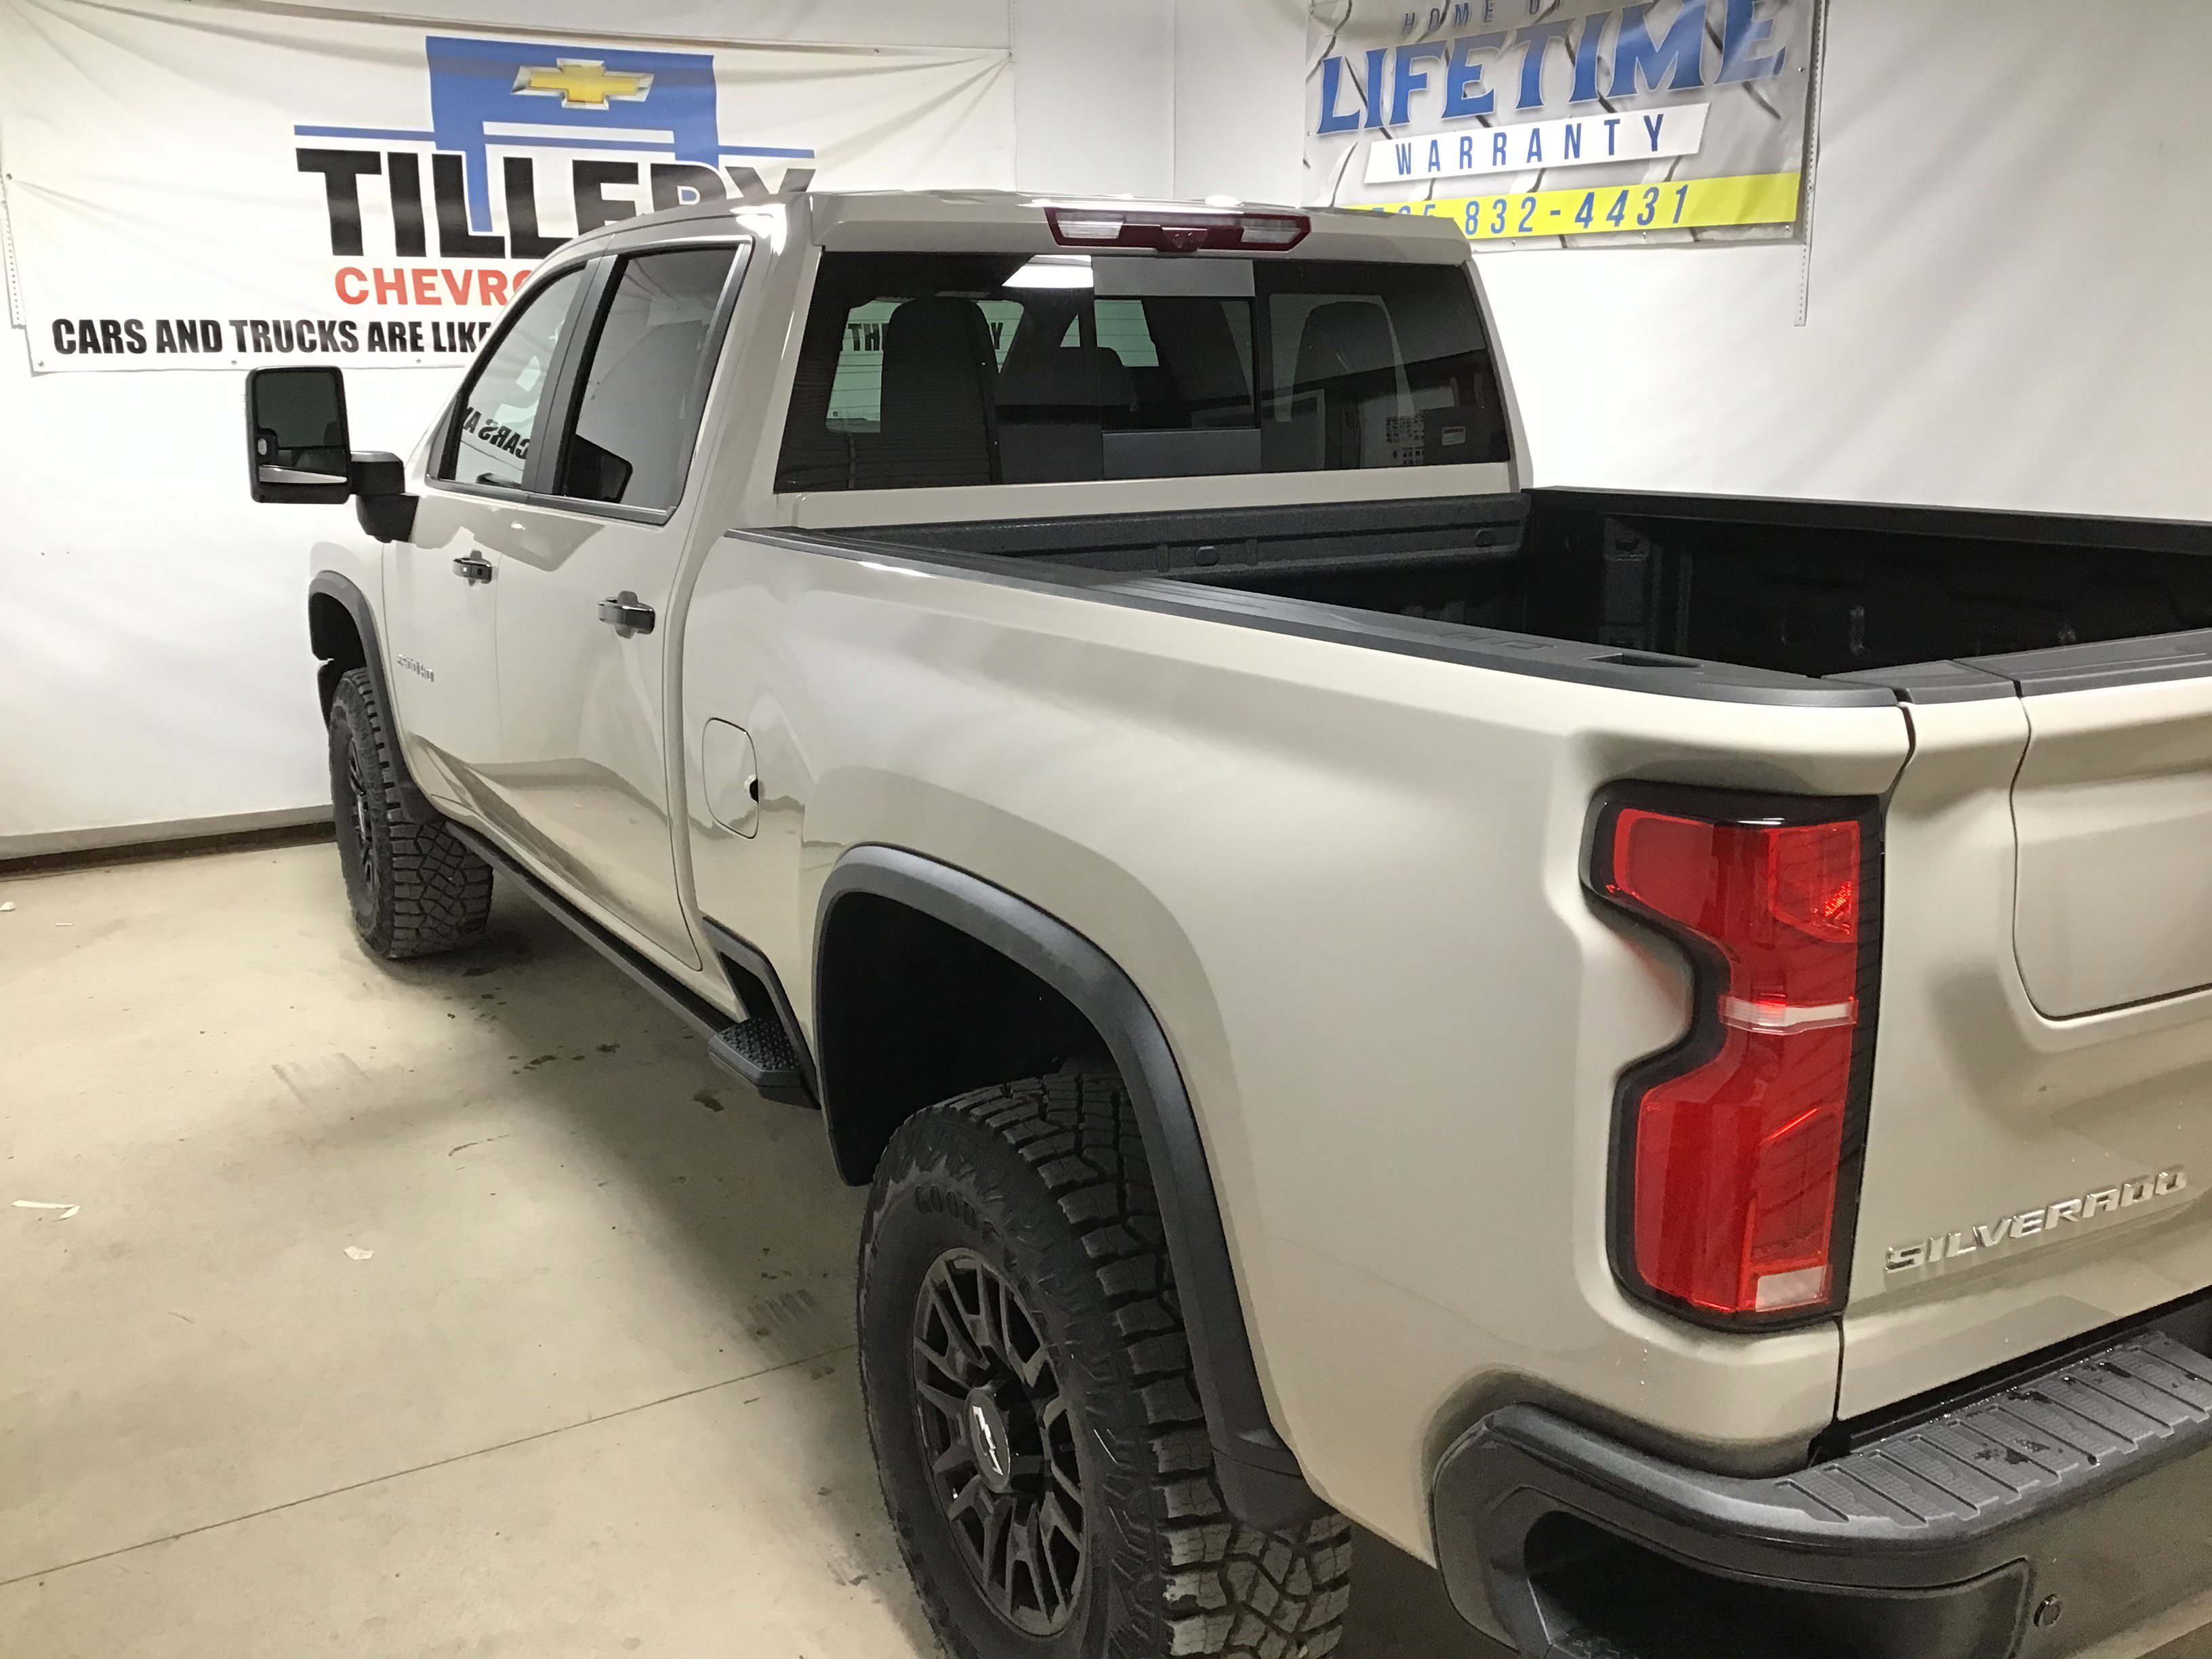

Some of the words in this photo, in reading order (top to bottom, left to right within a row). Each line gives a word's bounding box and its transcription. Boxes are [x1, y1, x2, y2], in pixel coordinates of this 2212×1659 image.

[1401, 0, 1493, 34] HOME
[1316, 0, 1787, 135] LIFETIME
[1395, 113, 1664, 176] WARRANTY
[52, 318, 145, 354] CARS
[156, 319, 222, 352] AND
[229, 320, 358, 353] TRUCKS
[368, 321, 424, 353] ARE
[1884, 1170, 2188, 1274] SILVERADO
